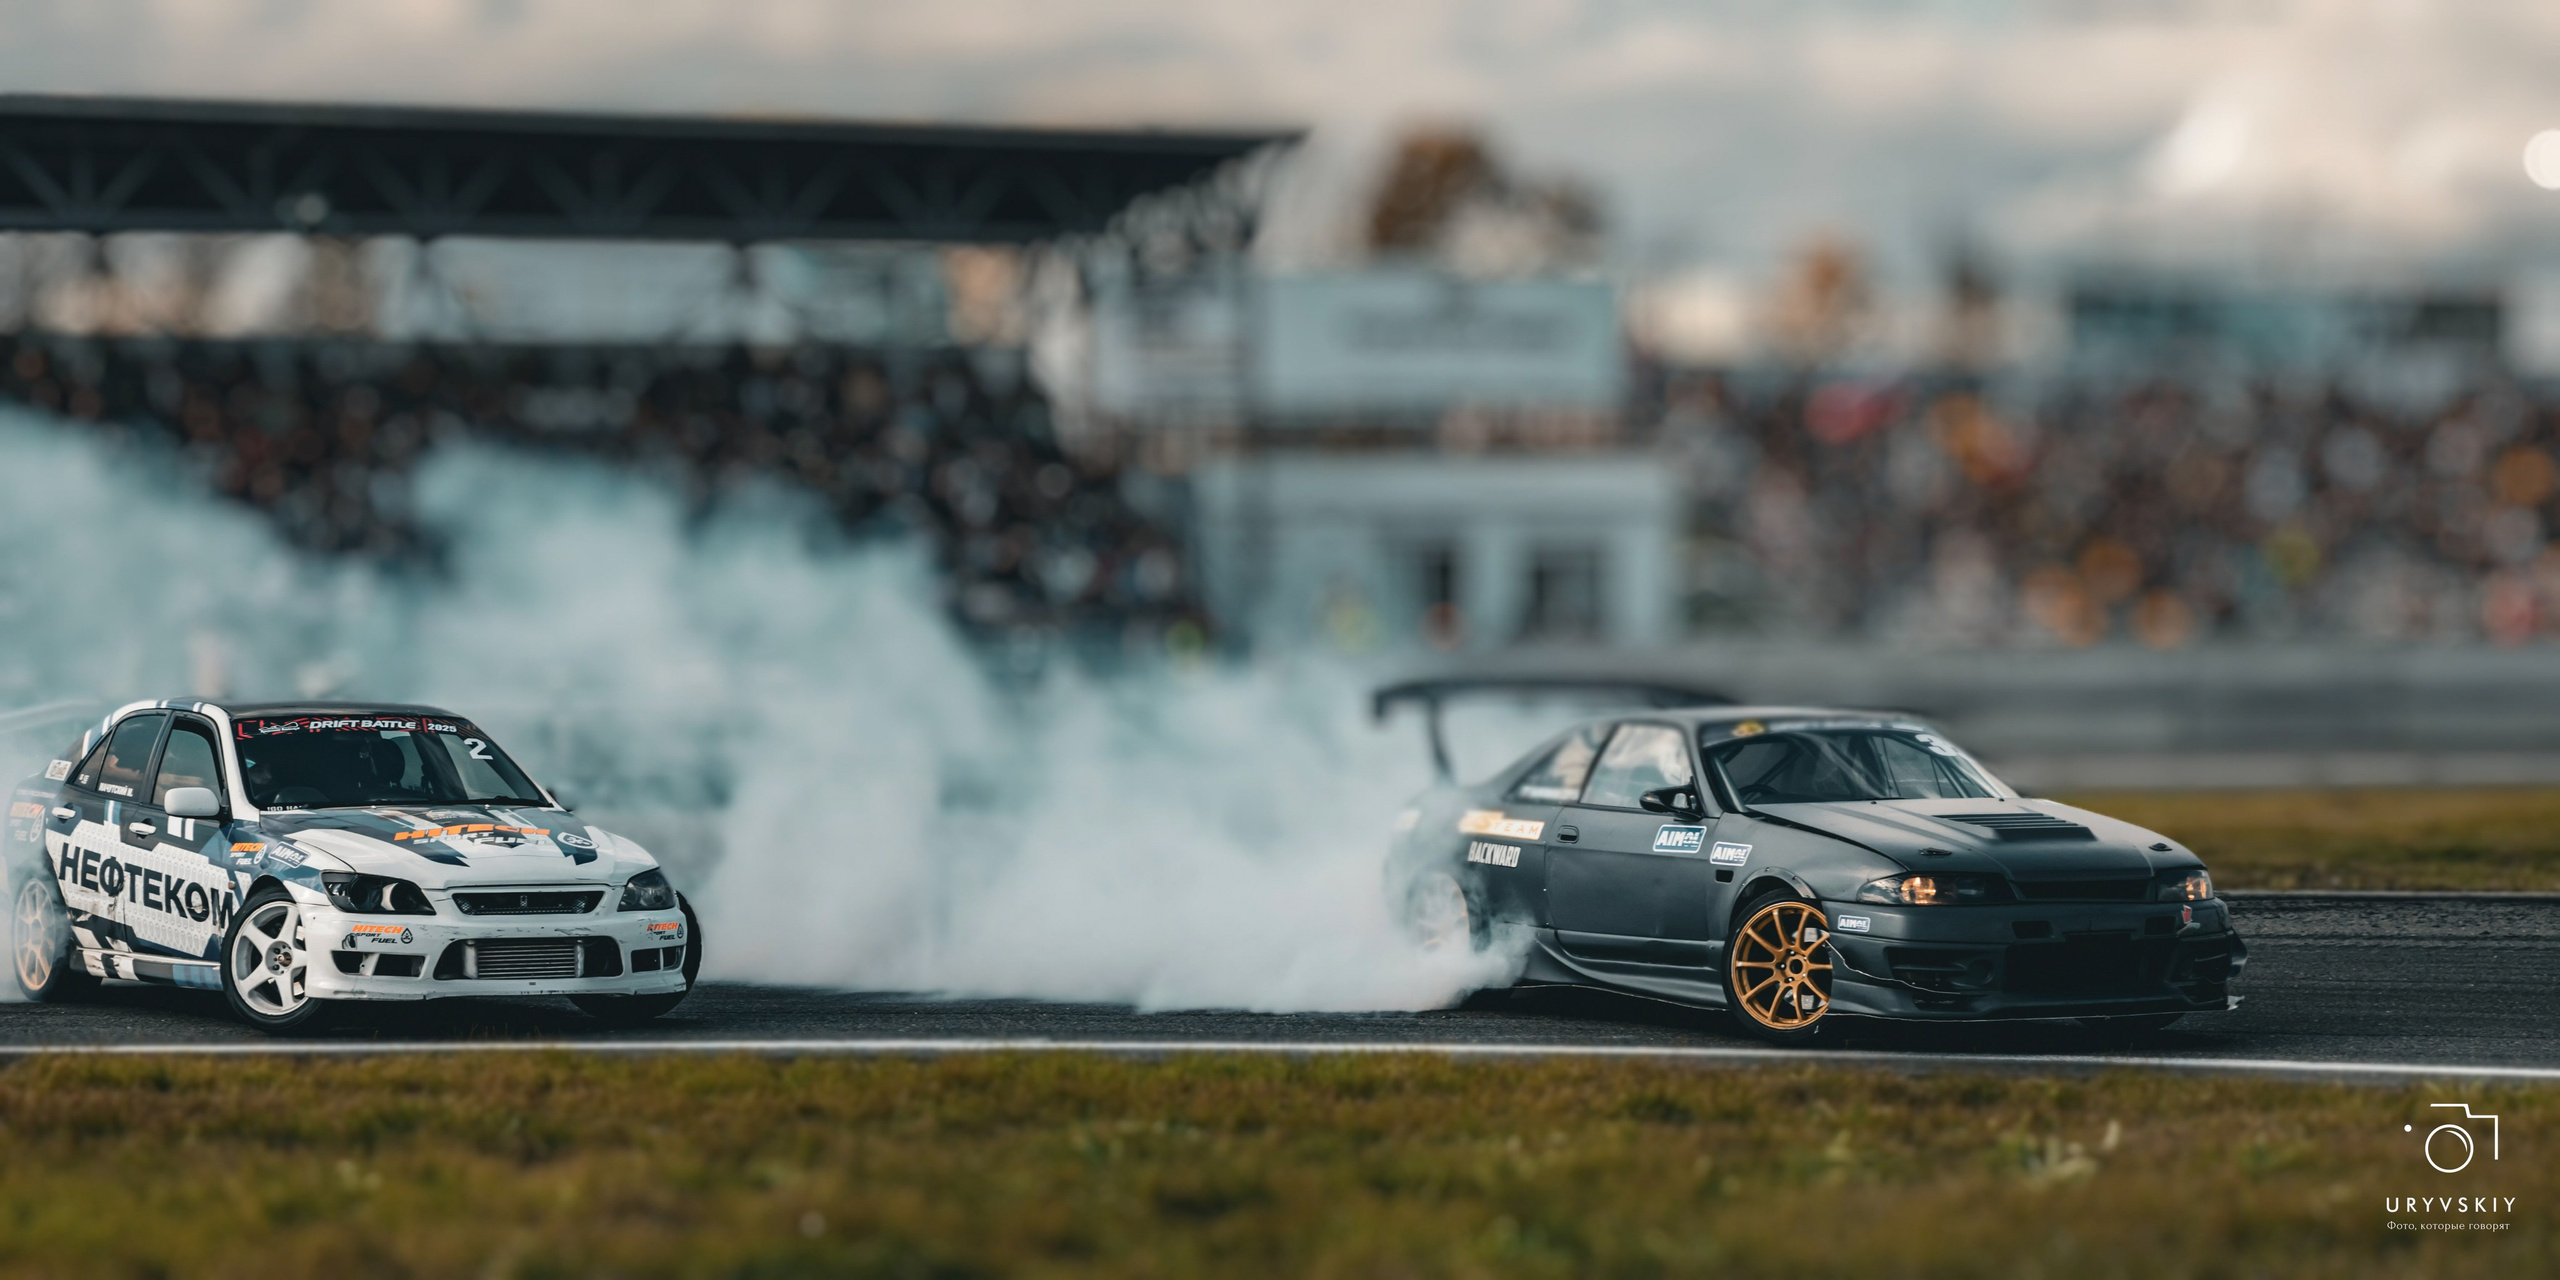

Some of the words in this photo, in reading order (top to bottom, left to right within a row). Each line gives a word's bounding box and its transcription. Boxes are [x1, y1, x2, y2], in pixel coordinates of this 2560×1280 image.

[310, 719, 360, 729] DRIFT
[361, 720, 416, 729] BATTLE
[427, 723, 457, 733] 2025
[463, 737, 494, 760] 2
[394, 823, 550, 841] HITECH
[1494, 822, 1540, 835] TEAM
[413, 832, 494, 845] SPORT
[1656, 830, 1701, 848] AIMOL
[230, 842, 265, 852] HITECH
[1467, 841, 1522, 868] BACKWARD
[1712, 846, 1747, 862] AIMOL
[235, 858, 252, 866] FUEL
[59, 842, 234, 929] НЕФТЕКОМ
[352, 924, 404, 934] HITECH
